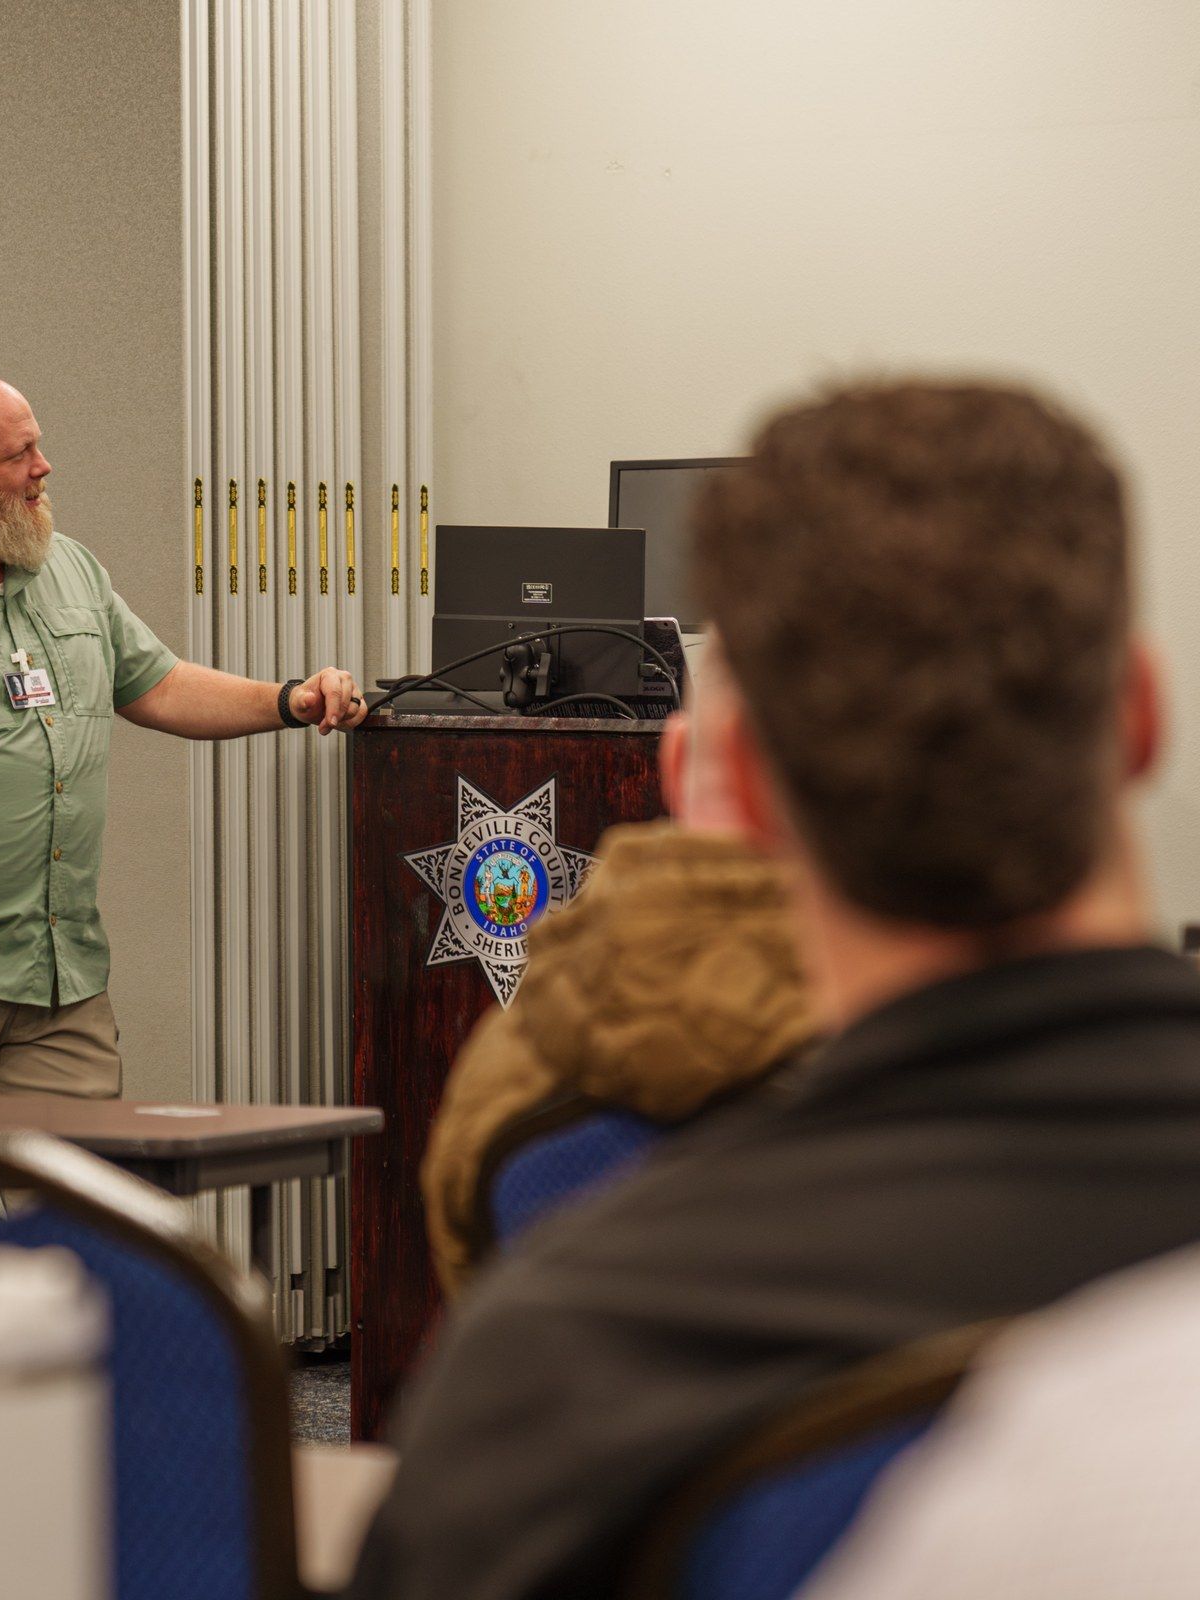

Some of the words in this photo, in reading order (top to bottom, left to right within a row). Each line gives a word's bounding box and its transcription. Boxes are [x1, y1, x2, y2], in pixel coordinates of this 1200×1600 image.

[475, 840, 515, 863] STATE
[520, 847, 537, 863] OF
[449, 820, 523, 916] BONNEVILLE
[529, 831, 564, 910] COUNT
[483, 920, 528, 937] IDAHO
[473, 932, 528, 957] SHERIF
